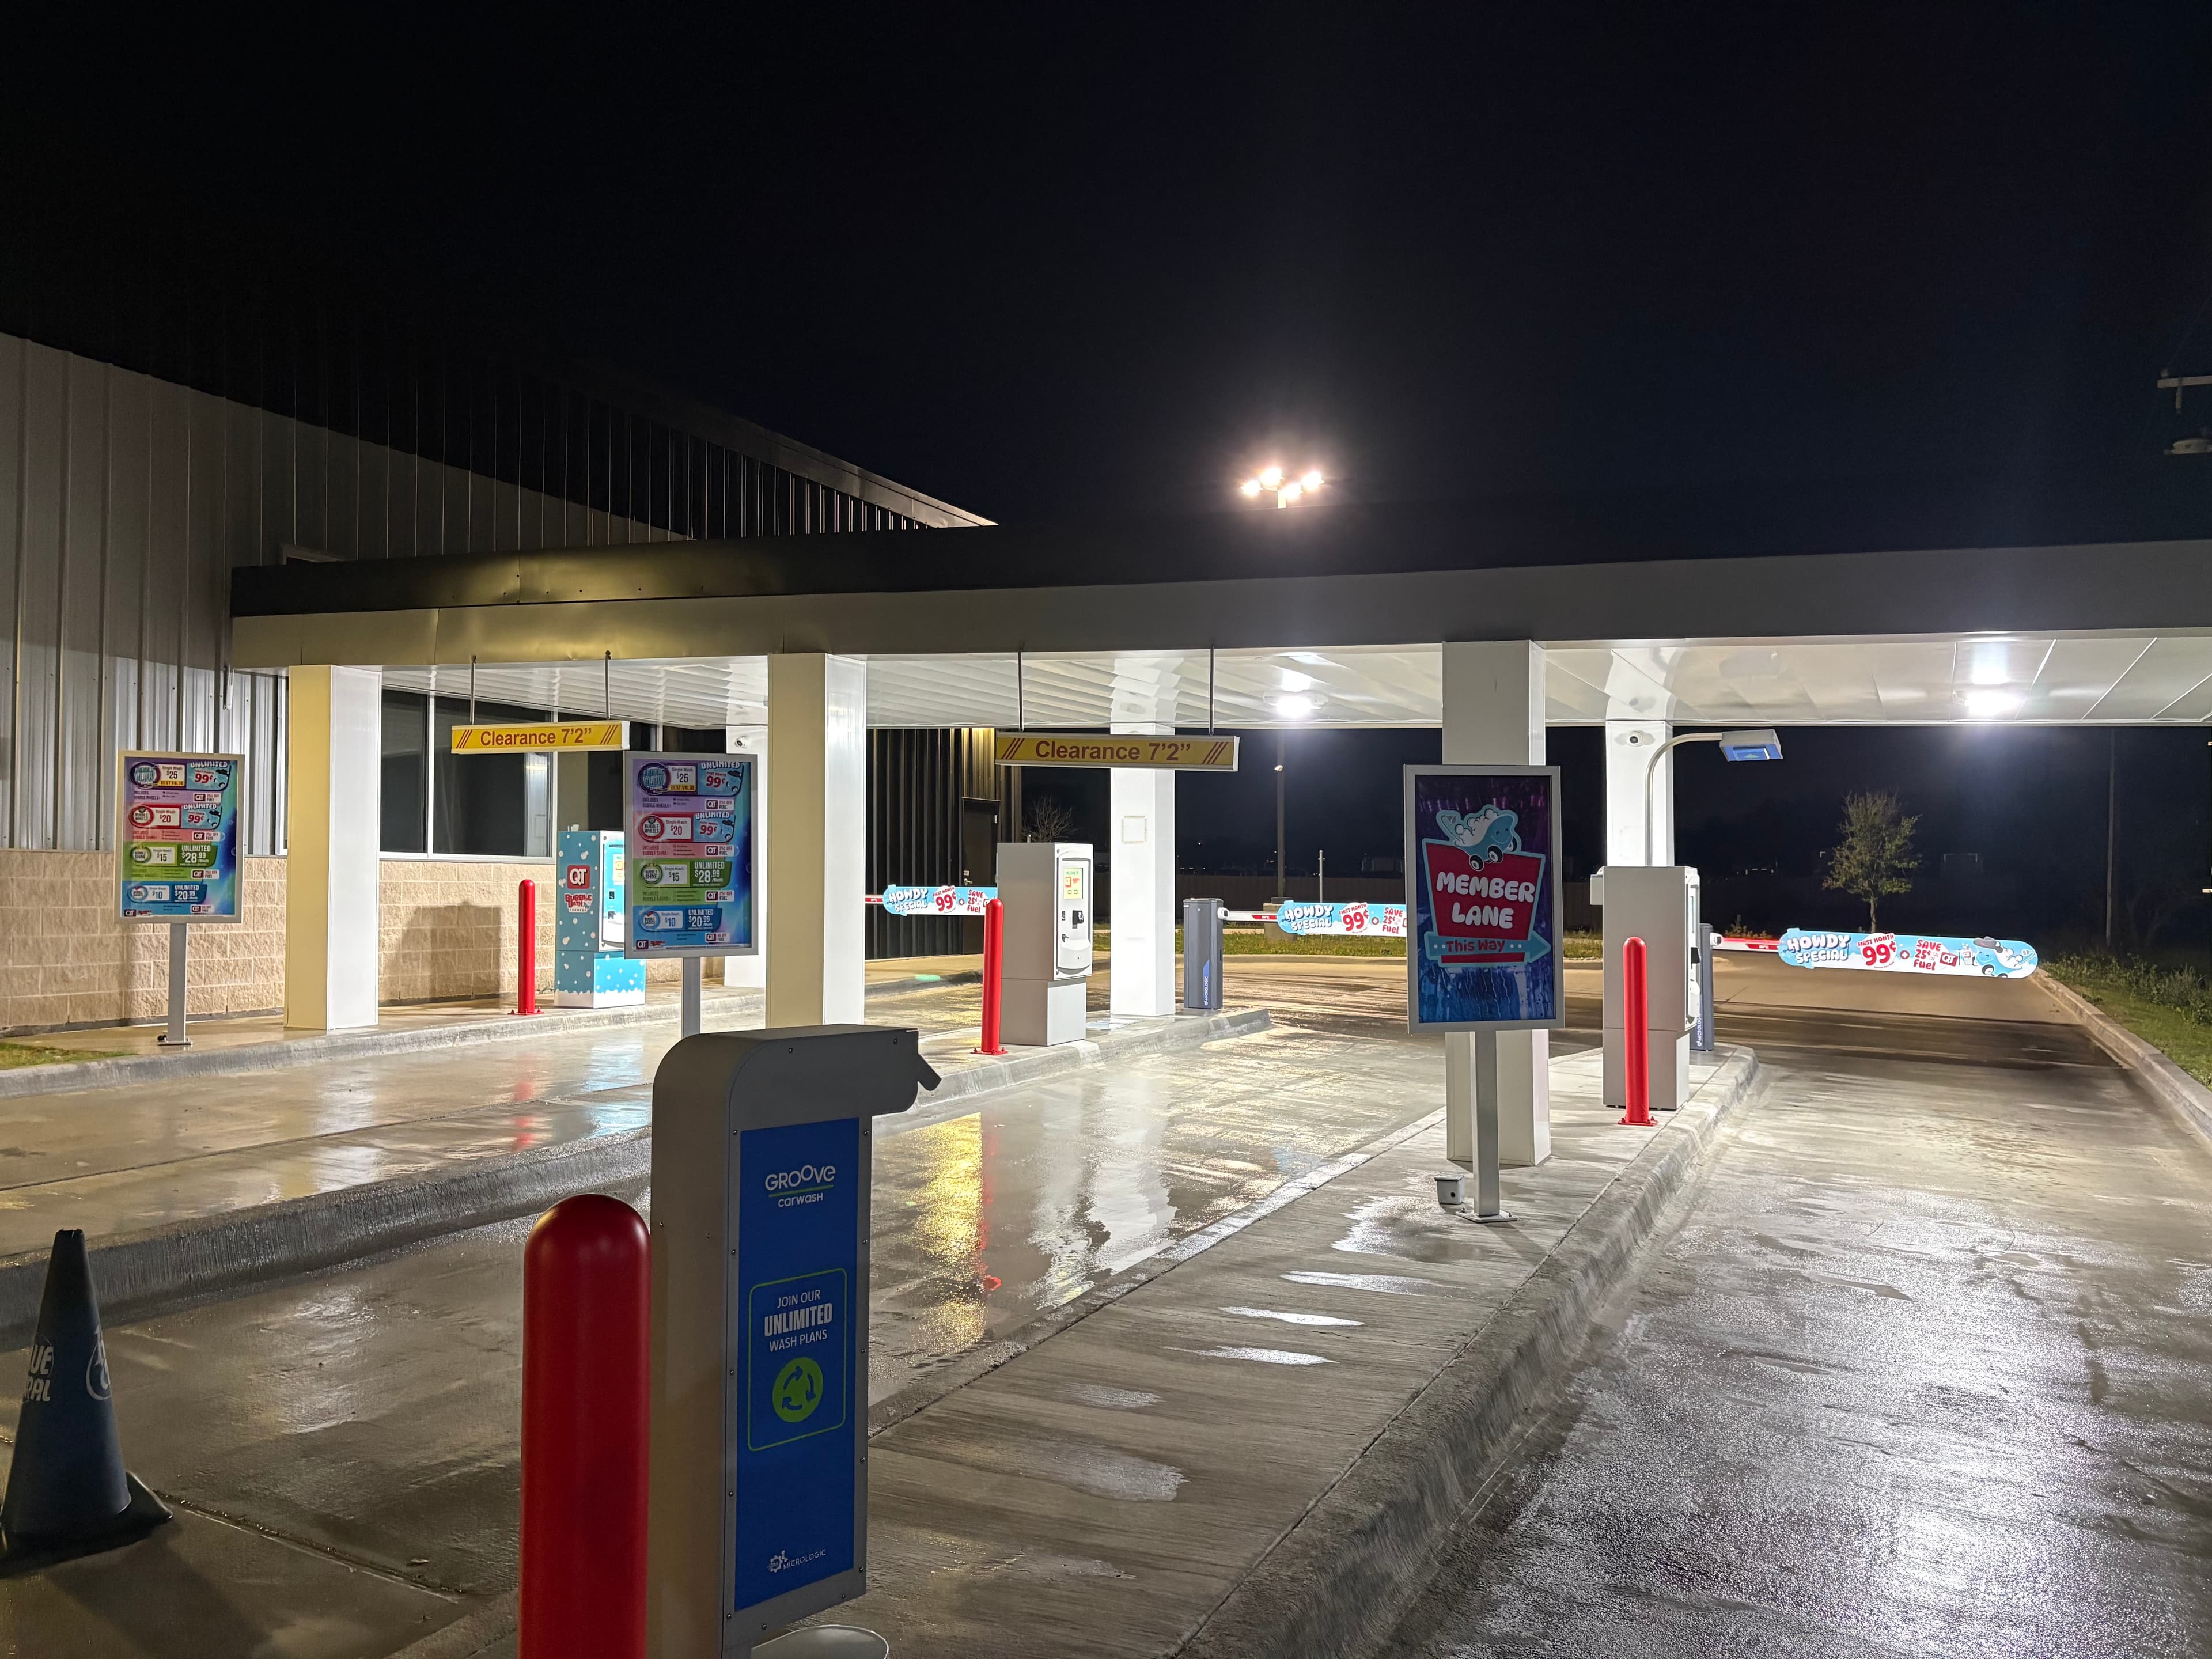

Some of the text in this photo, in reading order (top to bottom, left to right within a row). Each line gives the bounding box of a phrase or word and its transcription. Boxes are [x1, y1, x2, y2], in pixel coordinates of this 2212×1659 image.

[480, 730, 556, 746] Clearance
[1035, 740, 1141, 760] Clearance
[701, 761, 741, 770] UNLIMITED
[166, 771, 178, 779] $25
[677, 773, 689, 783] $25
[706, 775, 726, 789] 99¢
[160, 815, 171, 823] $20
[671, 825, 683, 835] $20
[700, 825, 717, 835] 99¢
[157, 853, 167, 861] $15
[569, 868, 588, 886] QT
[668, 872, 680, 882] $15
[1436, 871, 1535, 903] MEMBER
[153, 891, 163, 899] $10
[565, 894, 592, 902] BUBBLE
[889, 888, 929, 904] HOWDY
[968, 889, 983, 899] SAVE
[568, 899, 583, 908] BATH
[894, 900, 928, 912] SPECIAL
[935, 892, 956, 912] 99¢
[1351, 904, 1367, 912] MONTH
[1284, 904, 1334, 922] HOWDY
[1384, 907, 1404, 917] SAVE
[1452, 902, 1514, 929] LANE
[665, 917, 676, 927] $10
[1291, 918, 1332, 932] SPECIAL
[1343, 909, 1369, 932] 99¢
[1382, 924, 1399, 934] Fuel
[637, 940, 647, 948] QT
[1787, 934, 1851, 953] HOWDY
[1874, 934, 1894, 944] MONTH
[1446, 940, 1506, 953] This Way
[1916, 939, 1942, 952] SAVE
[1795, 949, 1849, 964] SPECIAL
[1862, 940, 1896, 967] 99¢
[1942, 954, 1956, 964] QT
[1914, 959, 1936, 971] Fuel
[777, 1290, 820, 1309] JOIN OUR
[764, 1303, 832, 1337] UNLIMITED
[769, 1329, 827, 1352] WASH PLANS
[783, 1549, 825, 1569] MICROLOGIC
